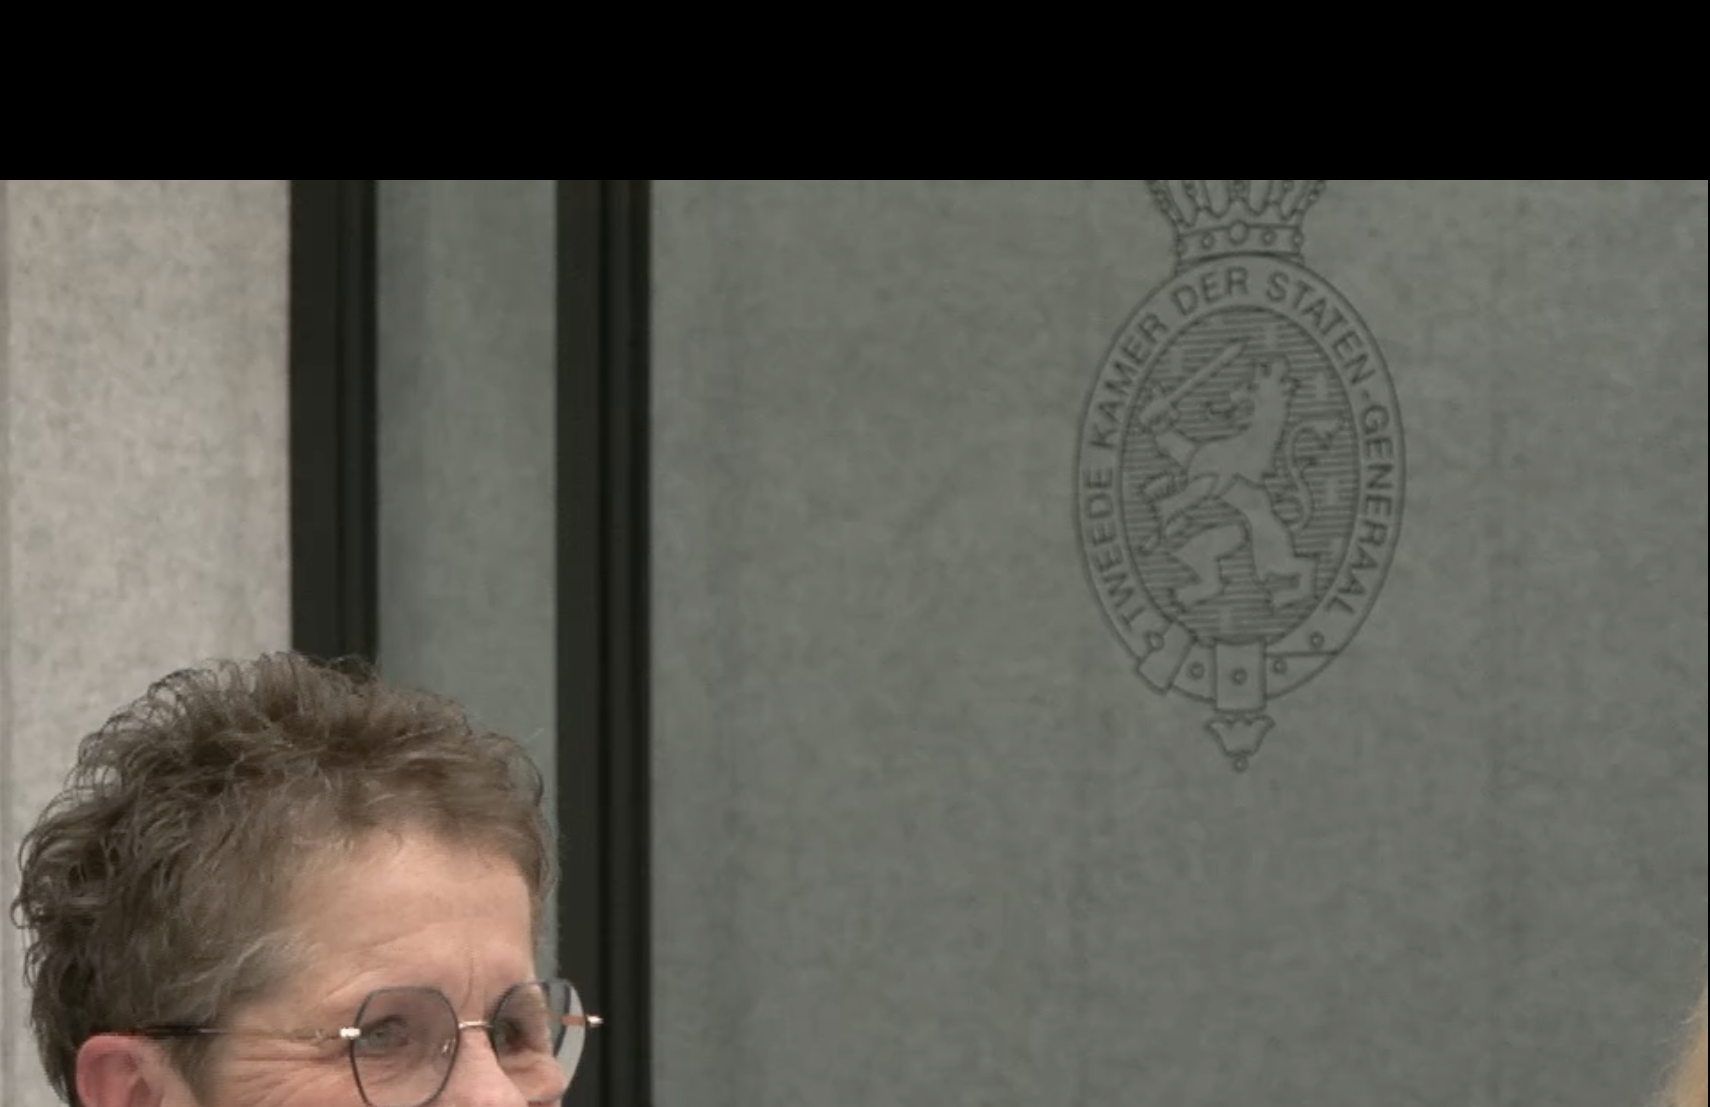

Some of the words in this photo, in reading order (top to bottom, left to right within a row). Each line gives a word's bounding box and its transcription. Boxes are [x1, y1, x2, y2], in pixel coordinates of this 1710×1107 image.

[1171, 266, 1251, 316] DER
[1091, 312, 1170, 450] KAMER
[1265, 269, 1392, 618] STATEN-GENERAAL
[1084, 467, 1145, 633] TWEEDE
